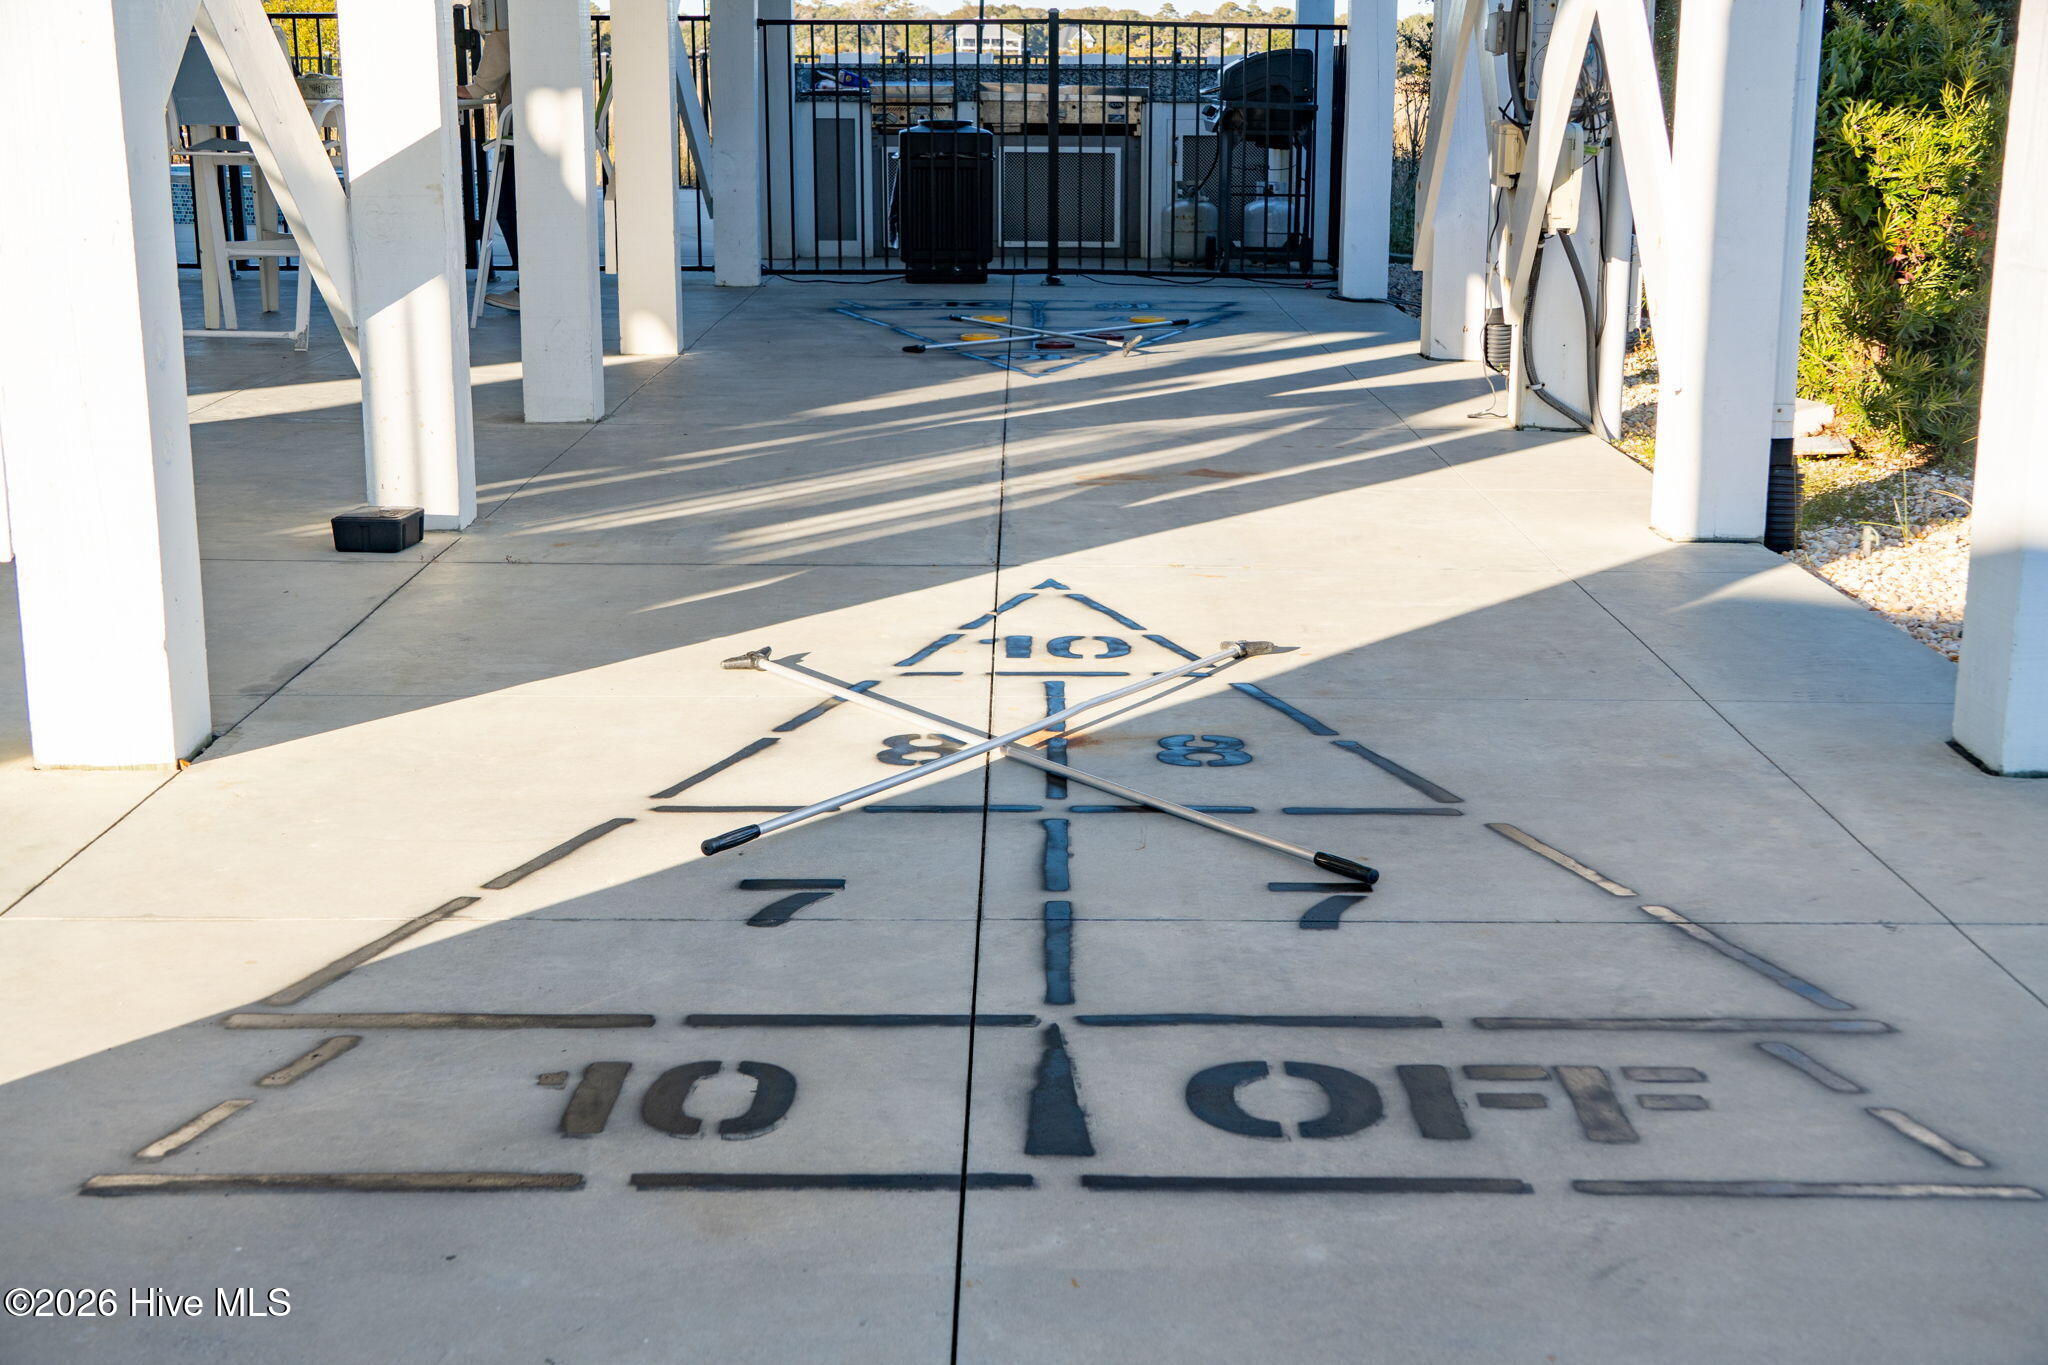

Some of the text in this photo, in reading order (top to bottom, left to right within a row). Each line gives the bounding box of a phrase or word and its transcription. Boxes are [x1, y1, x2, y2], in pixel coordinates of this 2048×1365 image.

[979, 635, 1132, 660] 10
[876, 733, 968, 766] 8
[1156, 734, 1253, 767] 8
[739, 879, 846, 927] 7
[1267, 882, 1373, 930] 7
[536, 1060, 1709, 1143] 10 OFF
